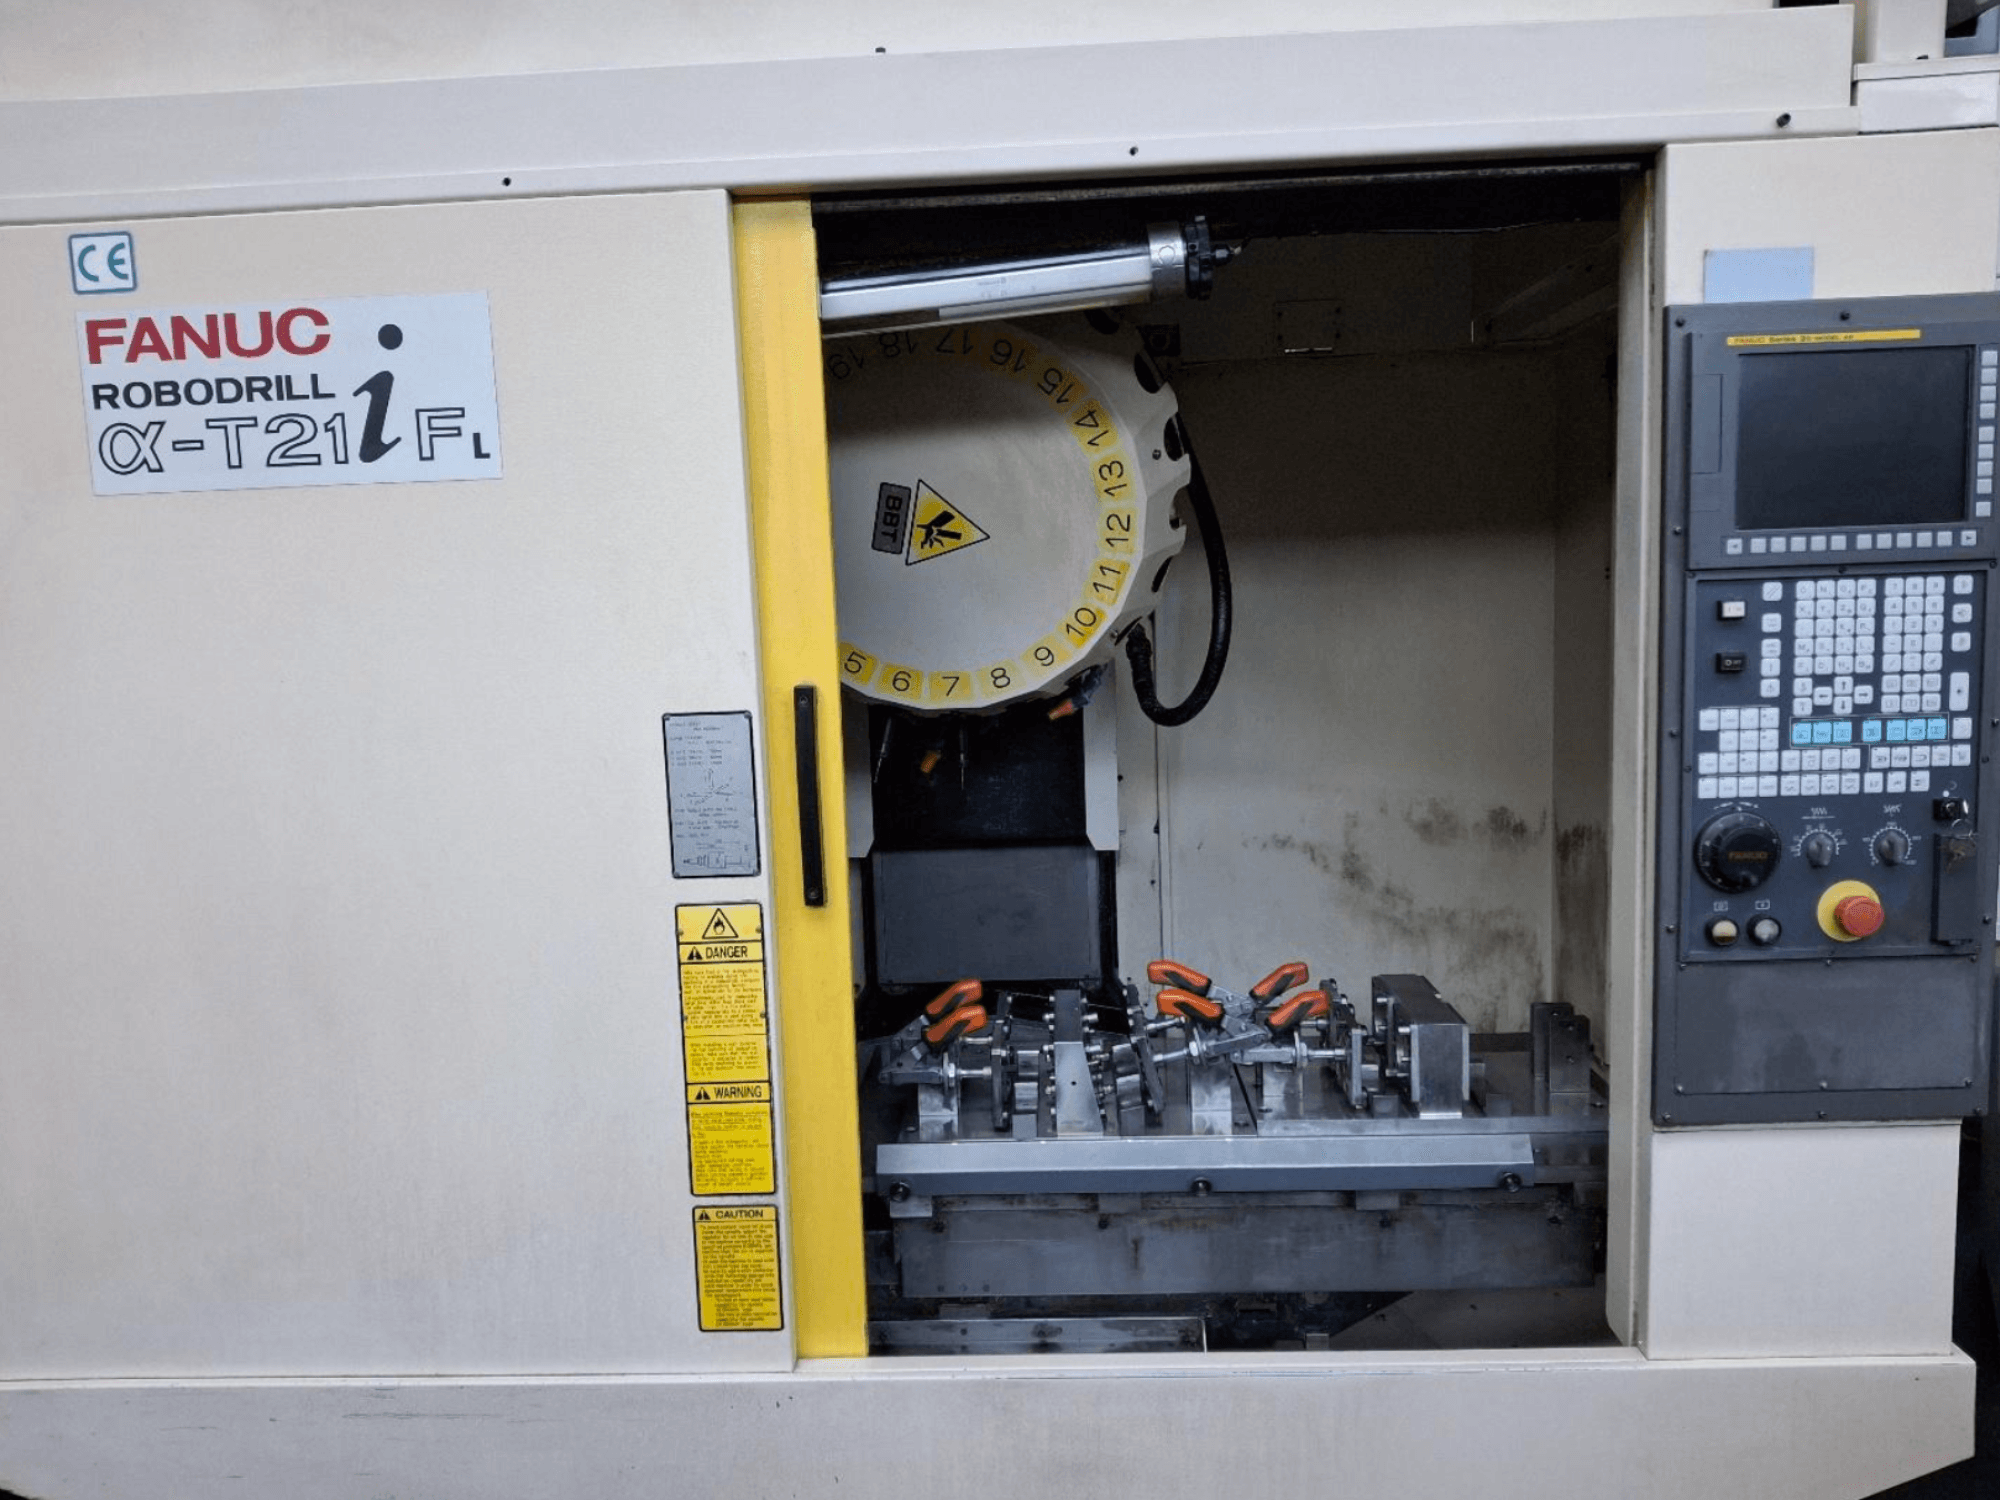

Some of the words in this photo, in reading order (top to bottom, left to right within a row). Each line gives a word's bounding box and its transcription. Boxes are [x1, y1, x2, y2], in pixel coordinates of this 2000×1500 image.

[78, 242, 129, 282] CE
[85, 307, 331, 364] FANUC
[878, 332, 919, 358] 18
[935, 328, 974, 355] 17
[827, 347, 864, 380] 19
[989, 338, 1027, 373] 16
[92, 373, 336, 410] ROBODRILL
[1037, 367, 1075, 406] 15
[1075, 409, 1109, 447] 14
[1098, 459, 1127, 498] 13
[1105, 513, 1132, 548] 12
[1093, 564, 1122, 593] 11
[1065, 607, 1097, 640] 10
[843, 651, 867, 674] 5
[1034, 646, 1055, 667] 9
[892, 670, 911, 692] 6
[941, 676, 960, 696] 7
[990, 667, 1011, 689] 8
[705, 945, 749, 959] DANGER
[714, 1085, 762, 1099] WARNING
[715, 1209, 764, 1219] CAUTION
